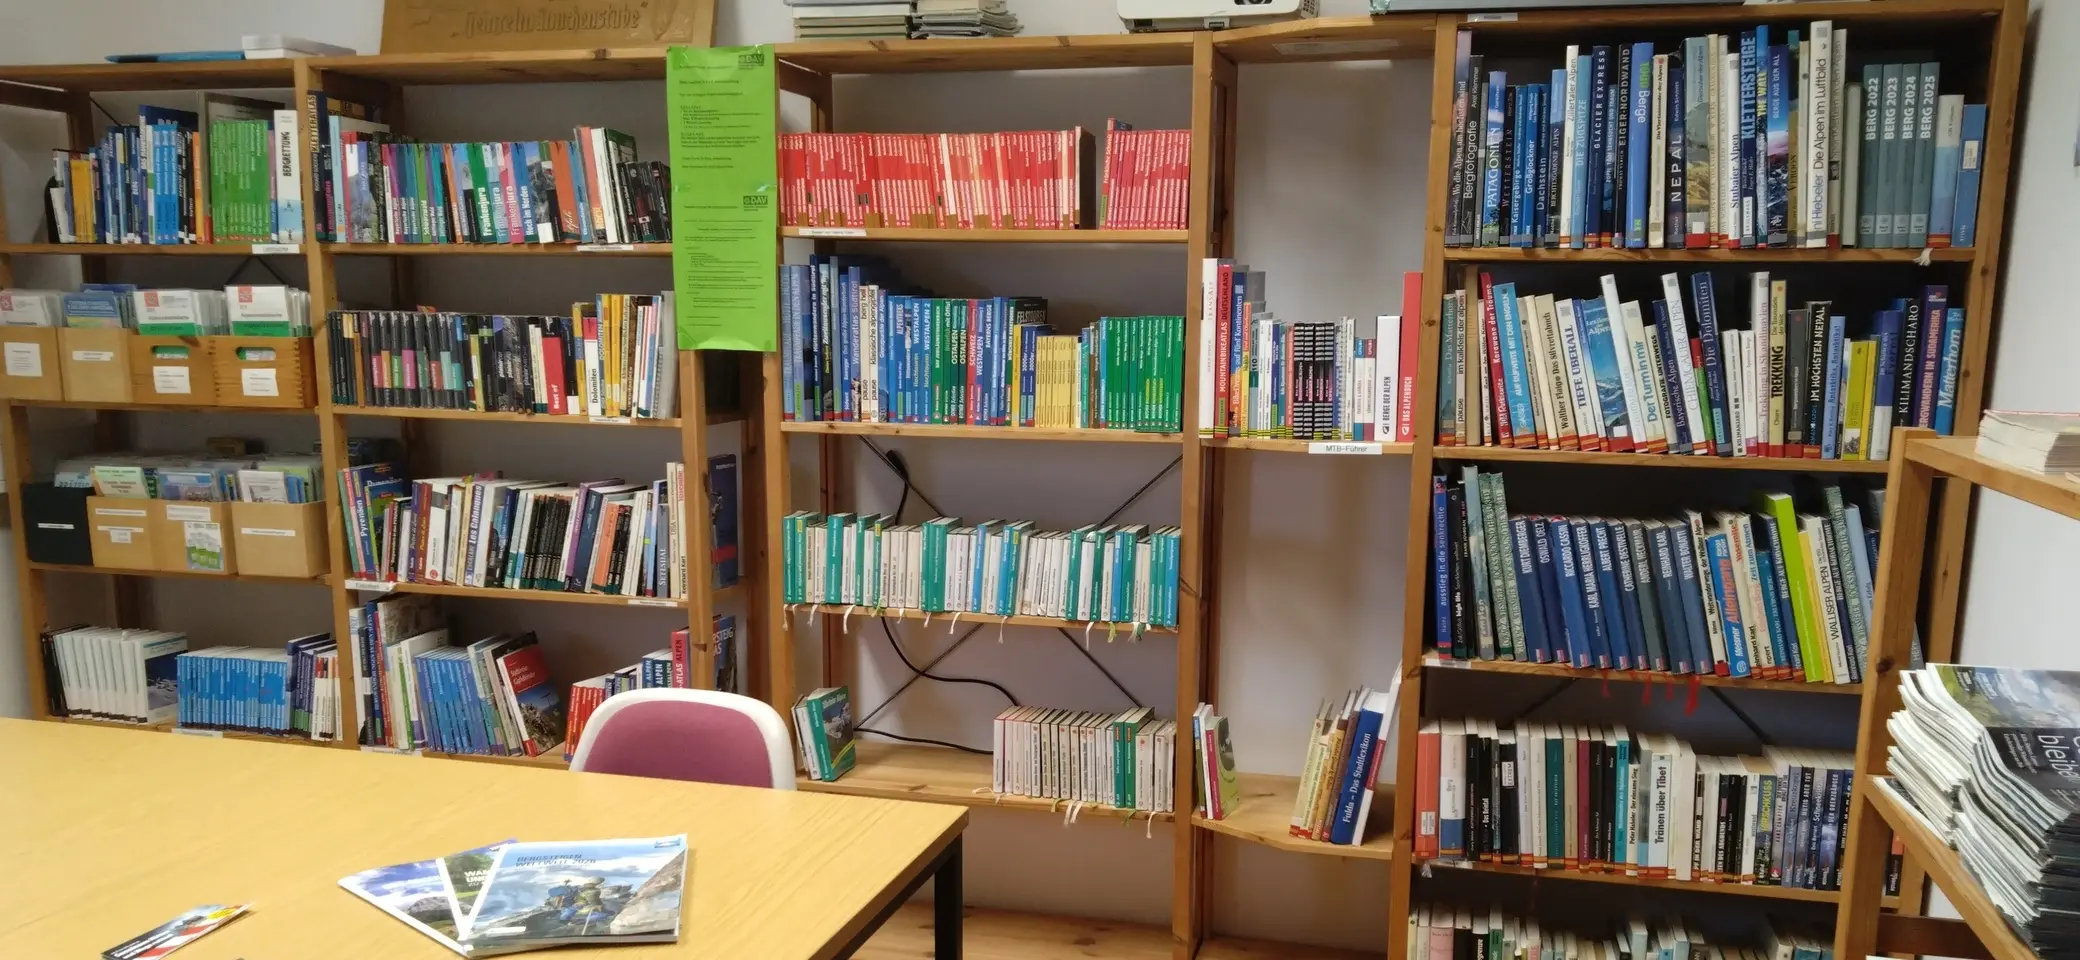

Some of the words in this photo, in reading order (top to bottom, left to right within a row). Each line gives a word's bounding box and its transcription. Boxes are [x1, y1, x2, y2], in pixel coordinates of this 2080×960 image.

[1458, 81, 1466, 97] sind
[1597, 50, 1605, 98] EXPRESS
[1741, 37, 1755, 139] KLETTERSTEIGE
[1816, 59, 1826, 98] Luftbild
[1568, 84, 1576, 122] Zillertaler
[1868, 77, 1879, 105] 2022
[1886, 77, 1898, 105] 2023
[1904, 76, 1916, 104] 2024
[1923, 76, 1936, 104] 2025
[1815, 101, 1825, 114] im
[1594, 103, 1602, 149] GLACIER
[1815, 117, 1825, 149] Alpen
[1865, 108, 1876, 141] BERG
[1884, 108, 1895, 140] BERG
[1902, 107, 1914, 139] BERG
[1920, 107, 1932, 139] BERG
[281, 131, 291, 176] BERGRETTUNG
[1457, 134, 1463, 146] am
[1731, 134, 1740, 163] Alpen
[1455, 147, 1463, 169] Alpen
[1487, 128, 1500, 207] PATAGONIEN
[1526, 140, 1535, 194] Großglockner
[1671, 135, 1681, 202] NEPAL
[1813, 152, 1823, 169] Die
[521, 186, 531, 208] Norden
[1453, 184, 1461, 195] Wo
[1512, 170, 1521, 223] Kaisergebirge
[1537, 157, 1546, 210] Dachstein
[1729, 166, 1739, 209] Stubaier
[1813, 175, 1823, 219] Hiebeler
[478, 187, 492, 236] Frankenjura
[492, 187, 506, 236] Frankenjura
[506, 186, 520, 235] Frankenjura
[524, 210, 532, 218] im
[525, 220, 534, 235] Hoch
[869, 289, 877, 327] alpengipfel
[1221, 272, 1229, 320] DEUTSCHLAND
[1234, 296, 1243, 336] Kontinenten
[1699, 282, 1713, 342] Dolomiten
[1814, 307, 1825, 337] NEPAL
[869, 328, 877, 364] klassische
[1219, 322, 1228, 392] MOUNTAINBIKEATLAS
[1706, 346, 1717, 366] Die
[1899, 305, 1918, 413] KILIMANDSCHARO
[1458, 365, 1463, 374] im
[1667, 359, 1677, 383] Alpen
[1938, 328, 1961, 408] Matterhorn
[552, 384, 558, 392] of
[861, 380, 869, 400] pause
[1383, 376, 1391, 393] ALPEN
[1574, 377, 1587, 409] TIEFE
[1811, 389, 1820, 401] IM
[1673, 385, 1685, 427] Bayerische
[1918, 372, 1934, 428] ERGWANDERN
[356, 500, 368, 537] Pyrenäen
[1535, 522, 1545, 537] OELZ
[1516, 520, 1530, 557] DIEMBERGER
[1559, 524, 1570, 546] CASSIN
[1577, 526, 1593, 571] HERRLIGKOFFER
[1596, 527, 1608, 549] PRECHT
[1615, 526, 1629, 558] DESTIVELLE
[1657, 531, 1667, 546] KARL
[1677, 530, 1690, 555] BONATTI
[1523, 558, 1532, 573] KURT
[1538, 539, 1550, 563] OSWALD
[1563, 548, 1575, 577] RICCARDO
[1601, 550, 1612, 571] ALBERT
[1661, 548, 1672, 578] REINHARD
[1584, 573, 1596, 592] MARIA
[1622, 559, 1635, 591] CATHERINE
[1682, 556, 1694, 579] WALTER
[1820, 566, 1833, 594] ALPEN
[1588, 594, 1599, 608] KARL
[1825, 595, 1839, 640] WALLISER
[655, 664, 663, 685] ALPEN
[1354, 733, 1371, 778] Stadtlexikon
[2038, 735, 2080, 781] bleibe
[1350, 780, 1359, 793] Das
[1657, 767, 1666, 789] Tibet
[1342, 803, 1354, 823] Fulda
[1655, 791, 1666, 811] über
[1654, 813, 1665, 843] Tränen
